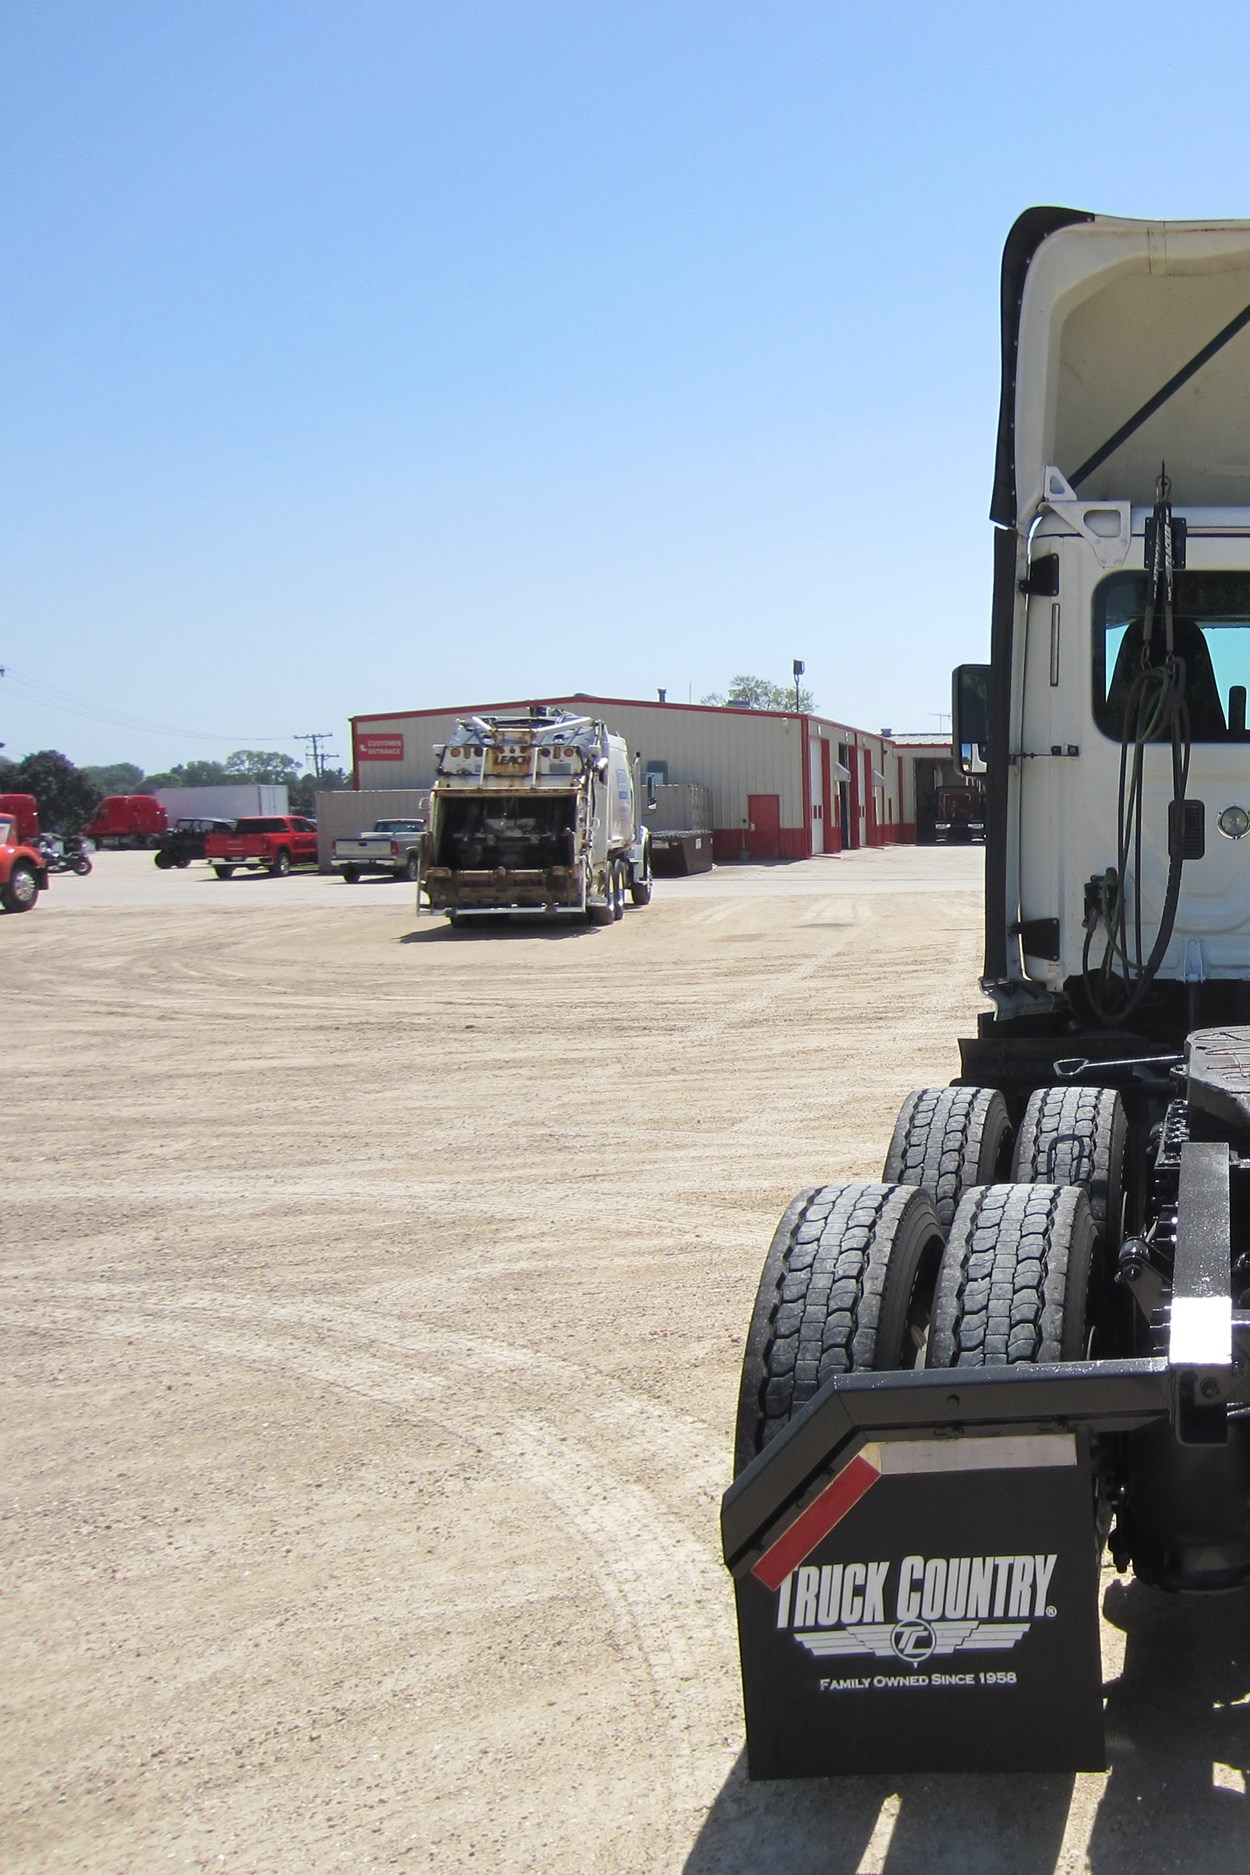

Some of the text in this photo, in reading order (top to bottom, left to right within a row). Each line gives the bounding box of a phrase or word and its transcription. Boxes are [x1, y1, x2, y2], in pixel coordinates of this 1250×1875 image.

[777, 1554, 1058, 1628] TRUCK COUNTRY
[819, 1671, 1018, 1691] FAMILY OWNED SINCE 1958
